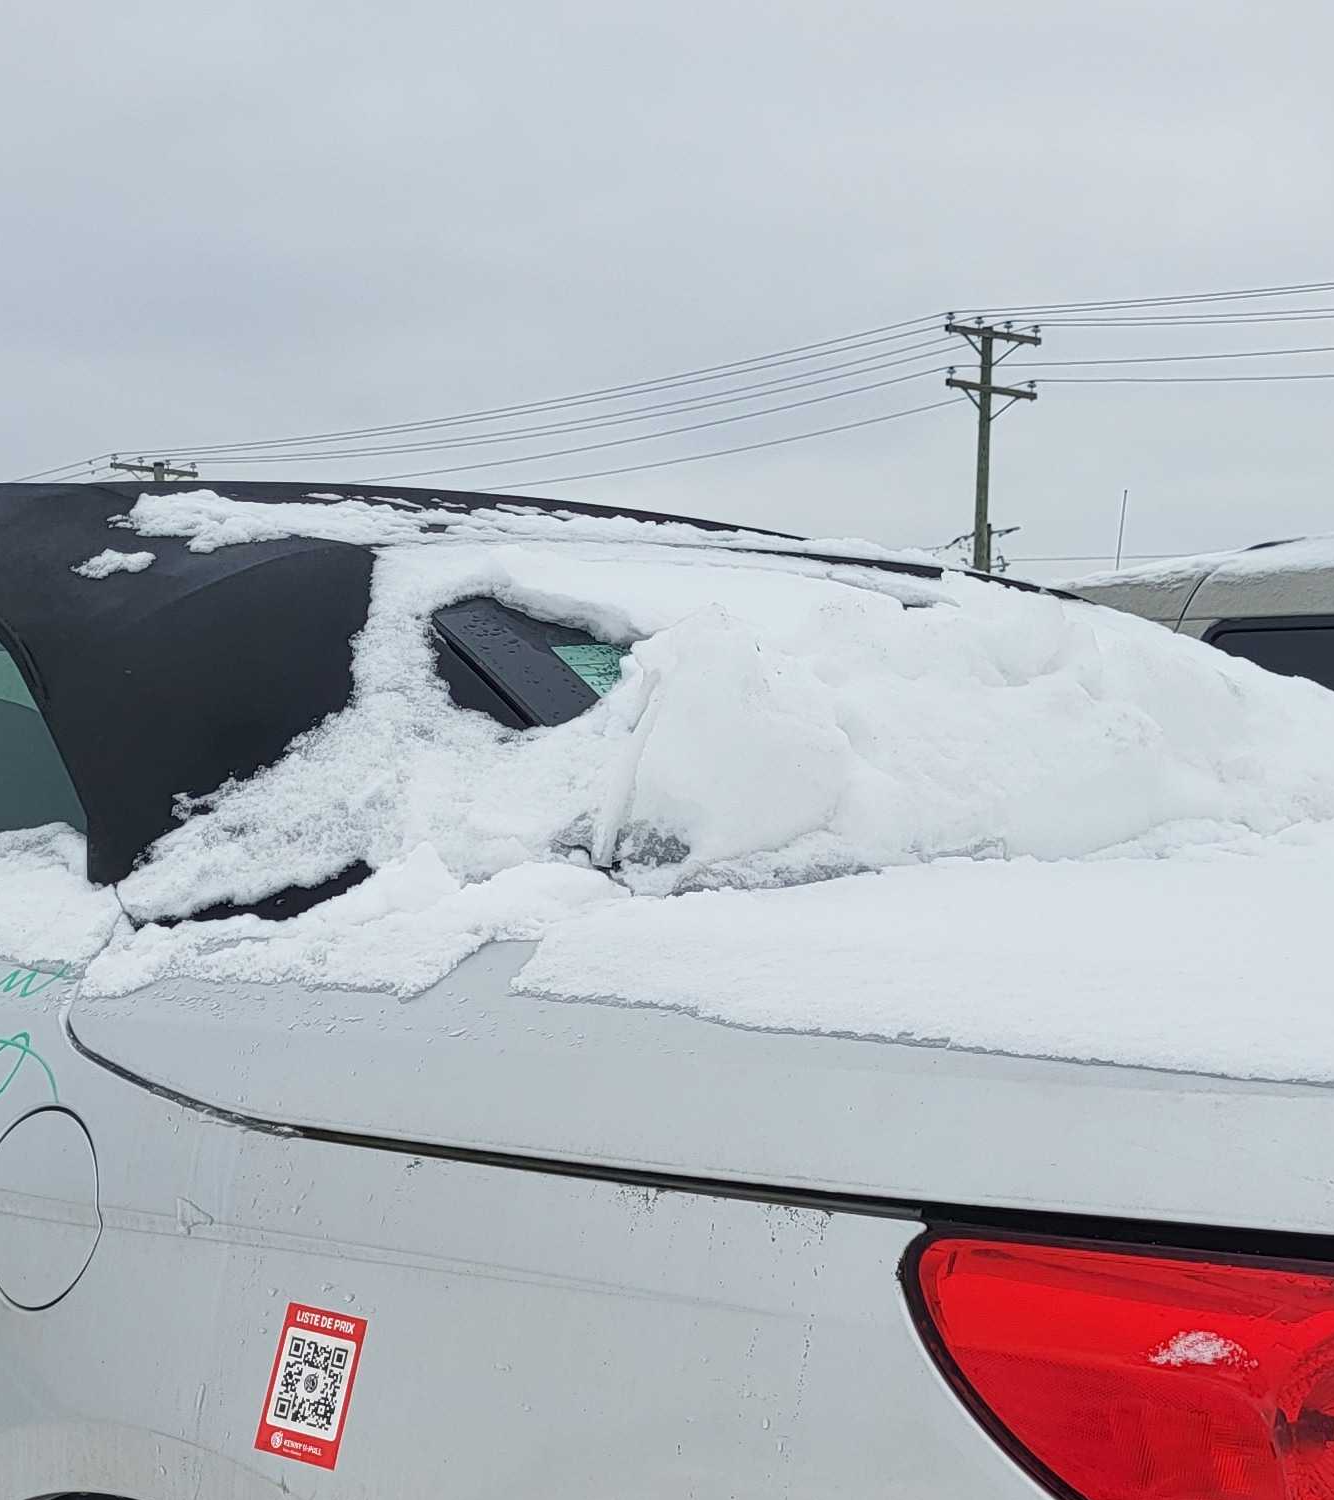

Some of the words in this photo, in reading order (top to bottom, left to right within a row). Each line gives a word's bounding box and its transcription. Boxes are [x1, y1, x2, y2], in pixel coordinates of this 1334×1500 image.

[296, 1310, 321, 1326] LISTE
[320, 1316, 334, 1329] DE
[333, 1319, 356, 1335] PRIX
